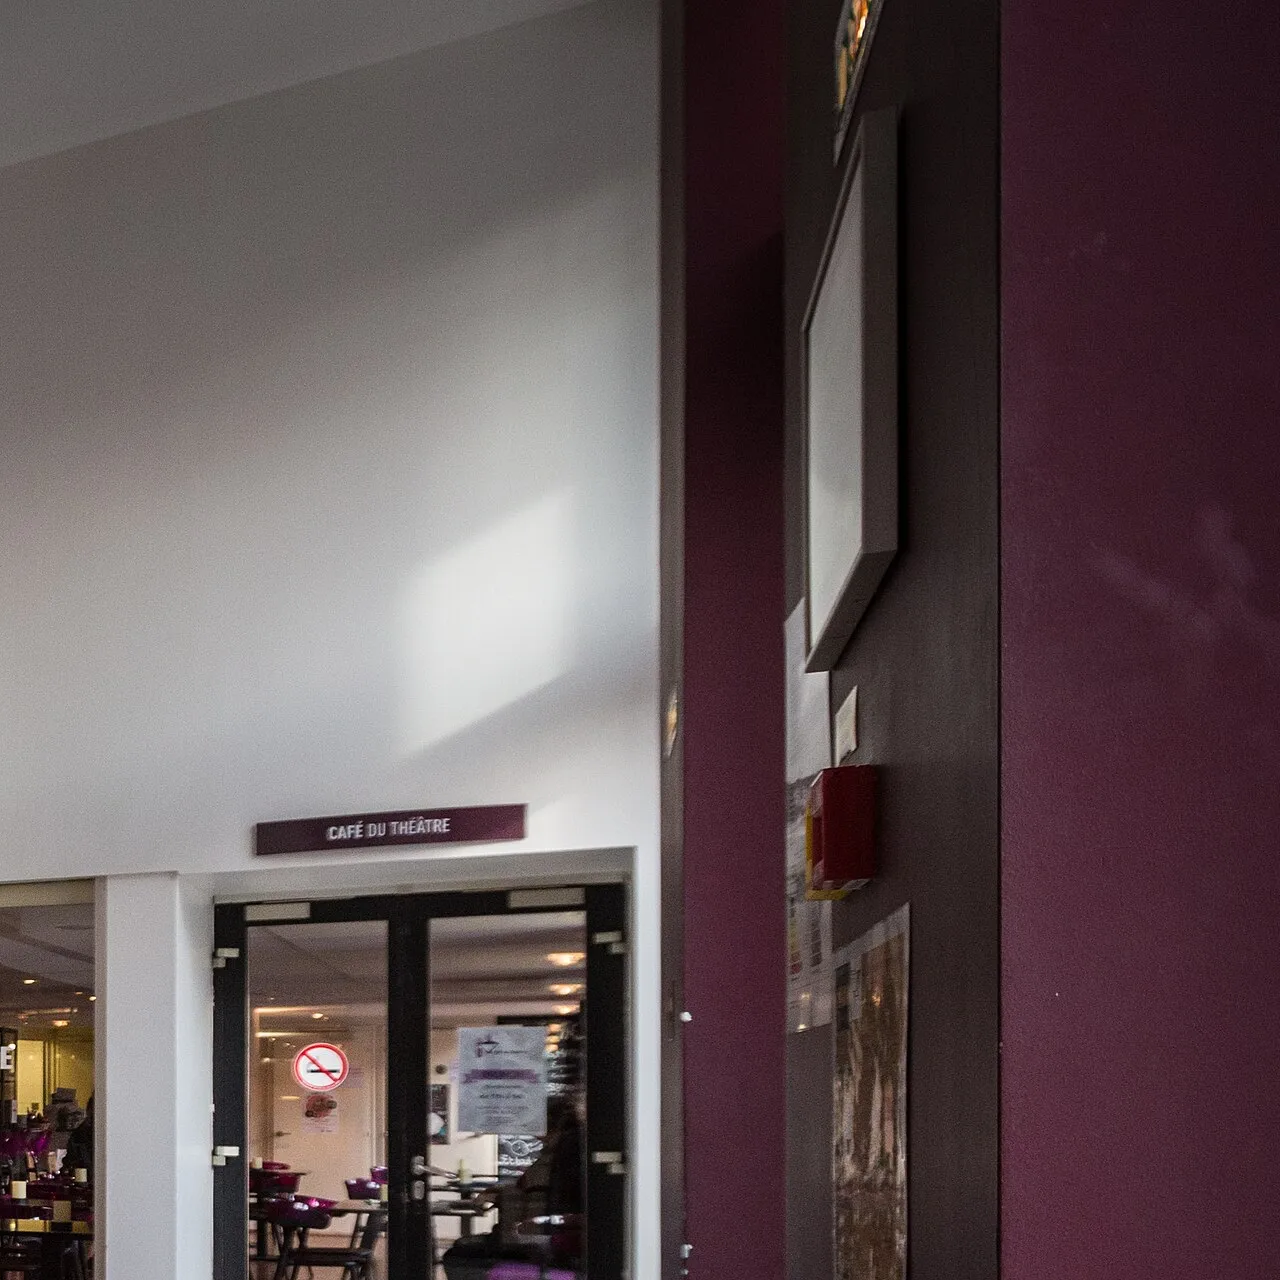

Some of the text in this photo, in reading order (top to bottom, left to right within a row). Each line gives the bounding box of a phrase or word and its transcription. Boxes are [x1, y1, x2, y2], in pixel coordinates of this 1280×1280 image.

[328, 815, 451, 840] CAFÉ DU THÉÂTRE
